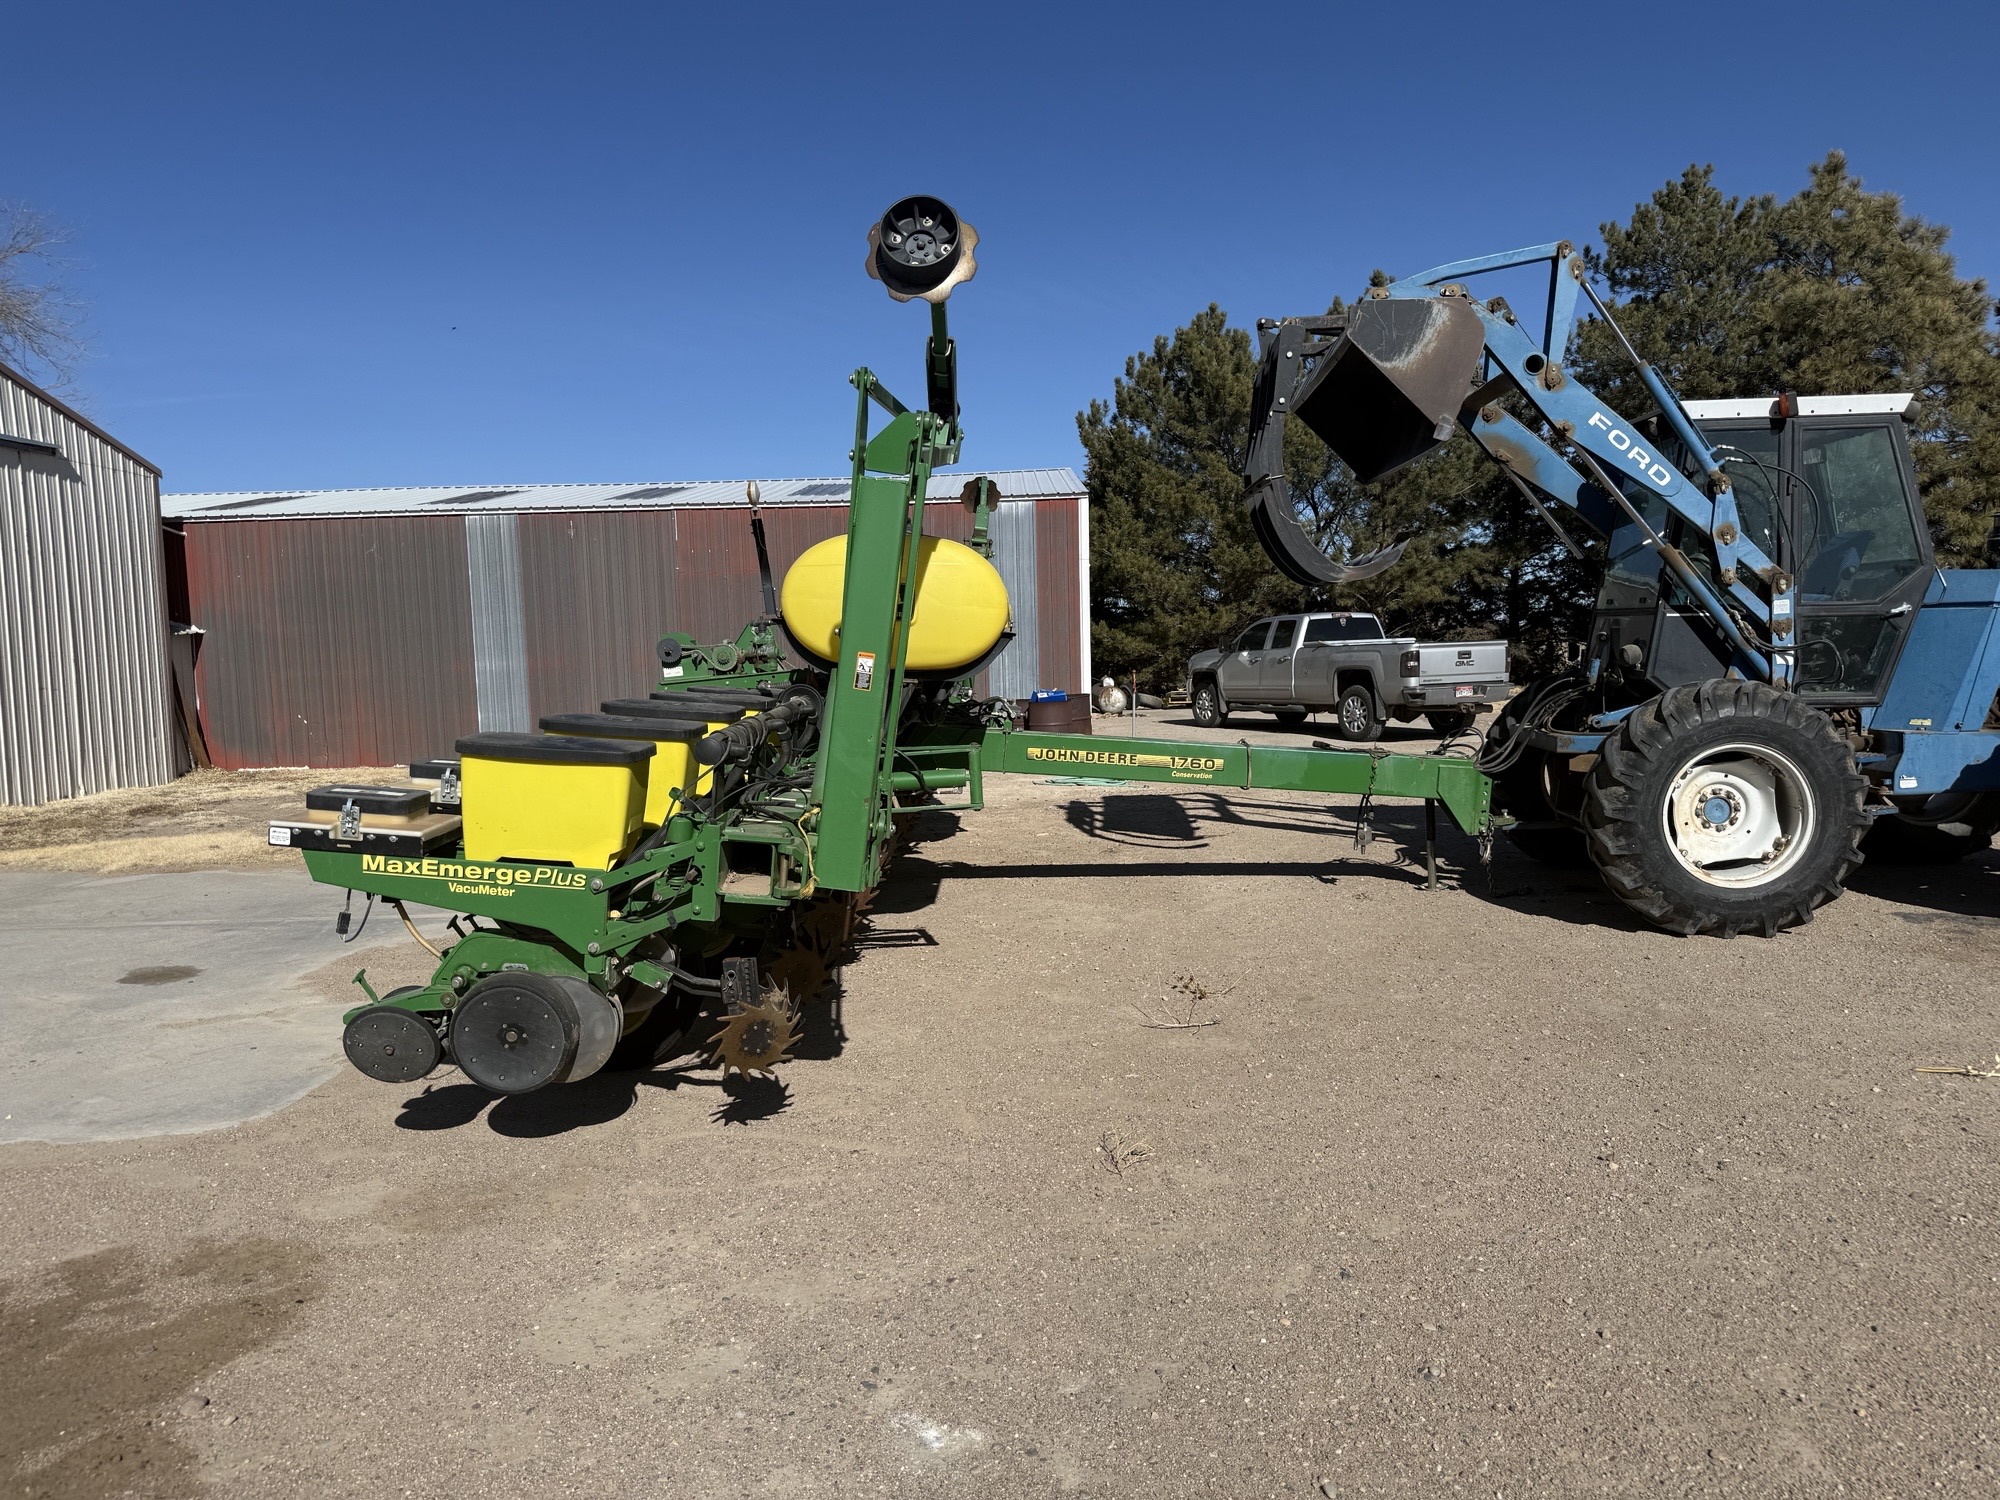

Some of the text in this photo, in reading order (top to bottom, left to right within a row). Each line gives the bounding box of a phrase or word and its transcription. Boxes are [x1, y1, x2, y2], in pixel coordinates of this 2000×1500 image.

[1588, 411, 1671, 486] FORD
[1035, 749, 1138, 765] JOHN DEERE
[1170, 757, 1216, 770] 1760
[1171, 770, 1213, 779] Conservation
[448, 882, 516, 897] VacuMeter
